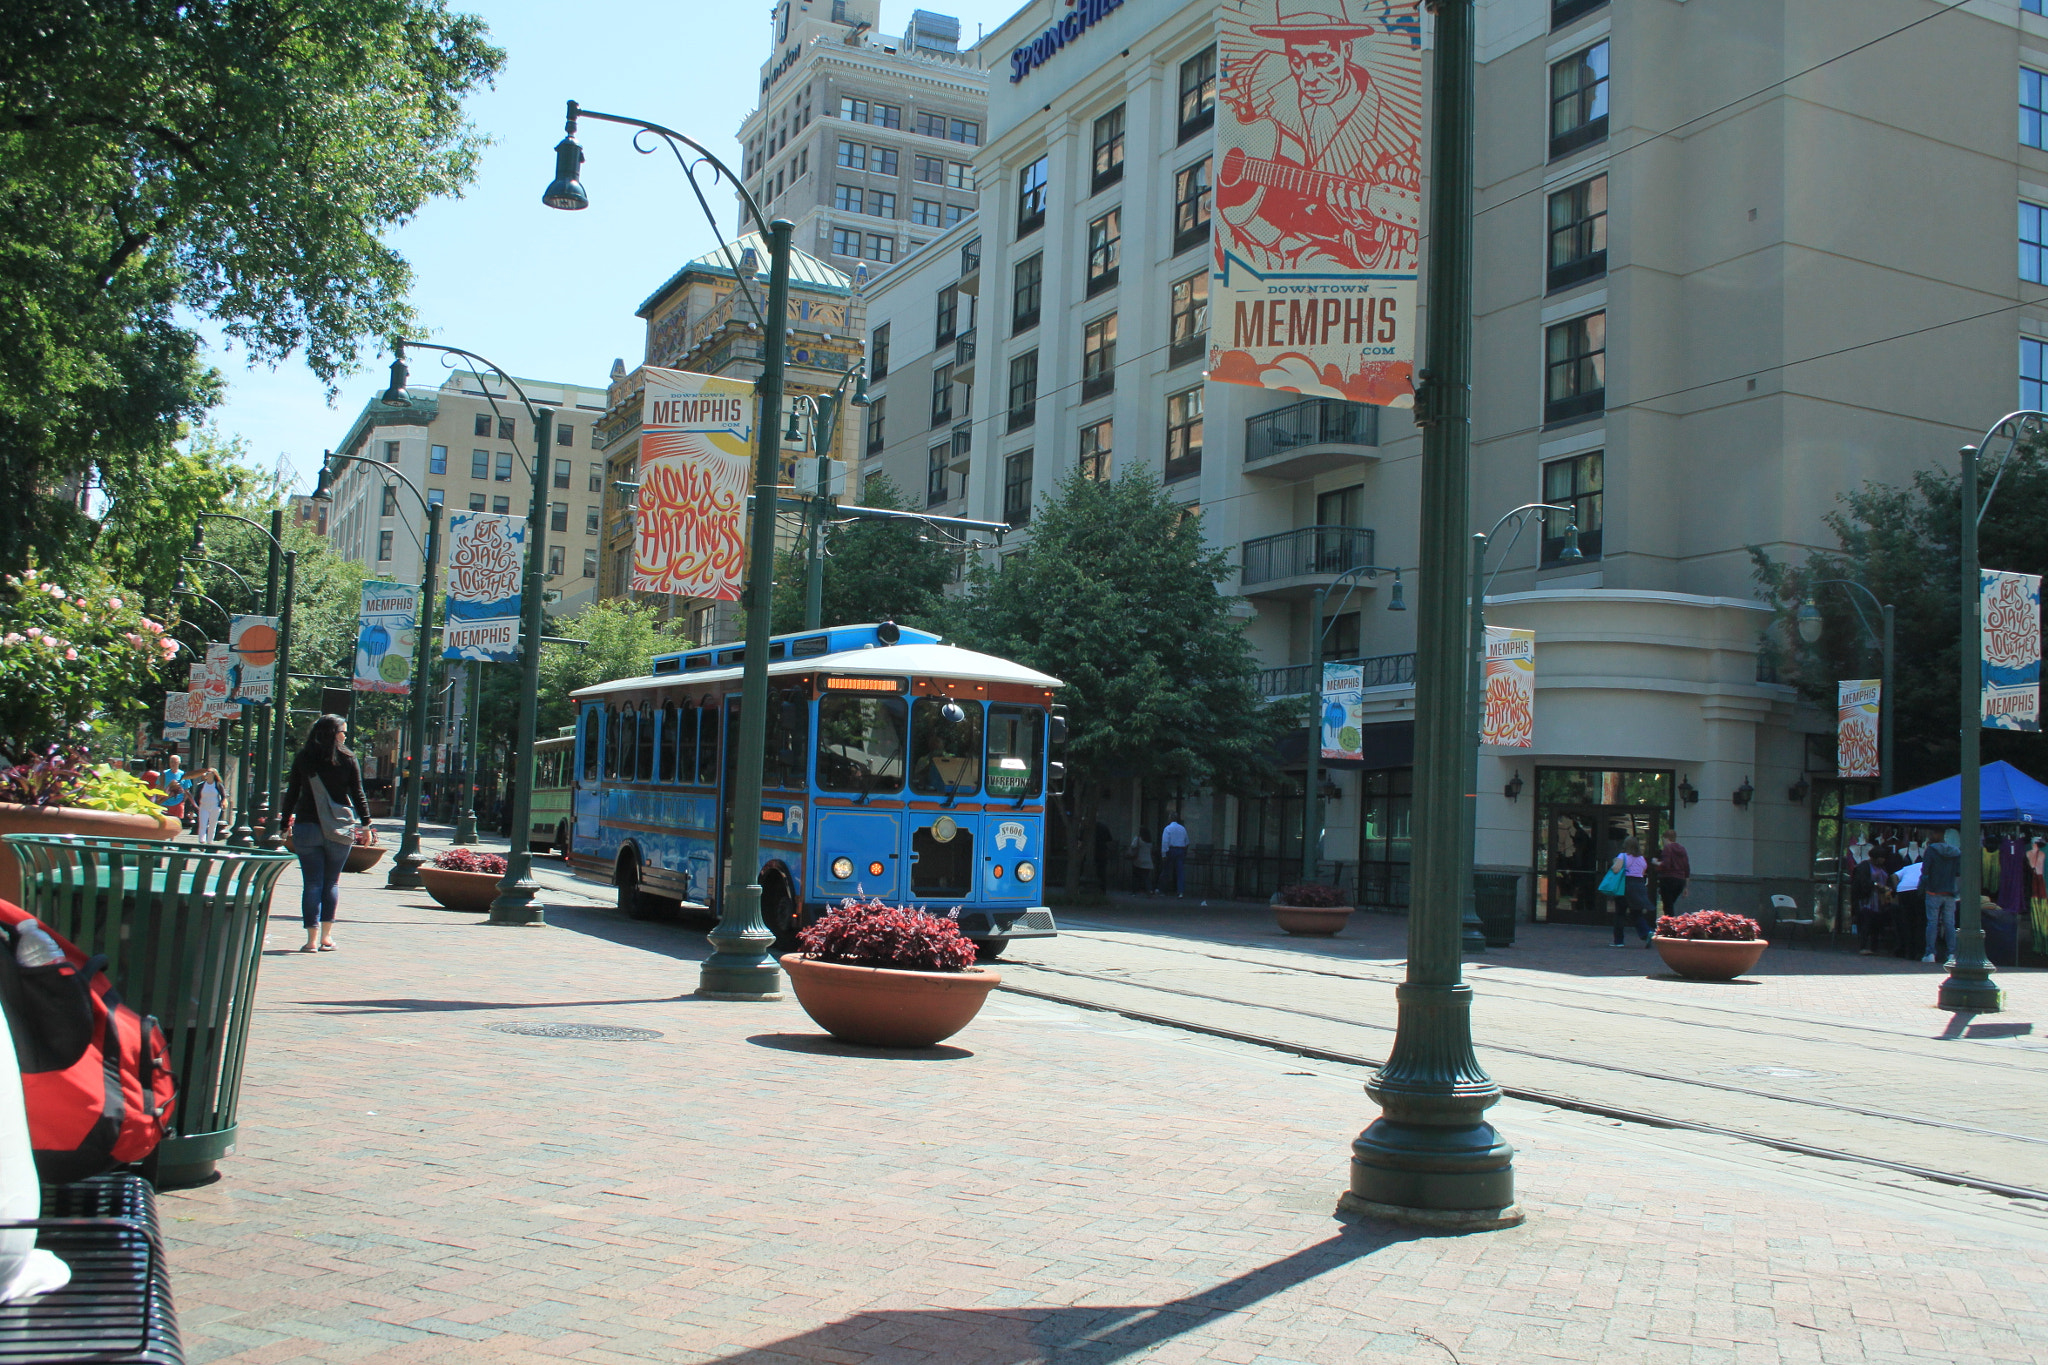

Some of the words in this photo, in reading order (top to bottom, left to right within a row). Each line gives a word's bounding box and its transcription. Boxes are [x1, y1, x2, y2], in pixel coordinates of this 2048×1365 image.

[1267, 284, 1370, 294] DOWNTOWN
[1234, 297, 1397, 348] MEMPHIS
[652, 399, 741, 424] MEMPHIS
[640, 461, 702, 511] LOVE
[698, 468, 735, 517] &
[471, 519, 502, 549] LETS
[637, 506, 744, 579] HAPPINESS
[456, 536, 512, 571] STAY
[450, 564, 521, 596] TOGETHER
[366, 597, 413, 612] MEMPHIS
[1999, 579, 2023, 611] LETS
[1987, 597, 2032, 636] STAY
[449, 626, 511, 647] MEMPHIS
[1490, 641, 1529, 657] MEMPHIS
[1983, 627, 2039, 661] TOGETHER
[1326, 677, 1360, 691] MEMPHIS
[1486, 676, 1511, 702] LOVE
[1842, 687, 1876, 705] MEMPHIS
[206, 702, 239, 712] MEMPHIS
[1986, 693, 2034, 715] MEMPHIS
[1485, 702, 1532, 737] HAPPINESS
